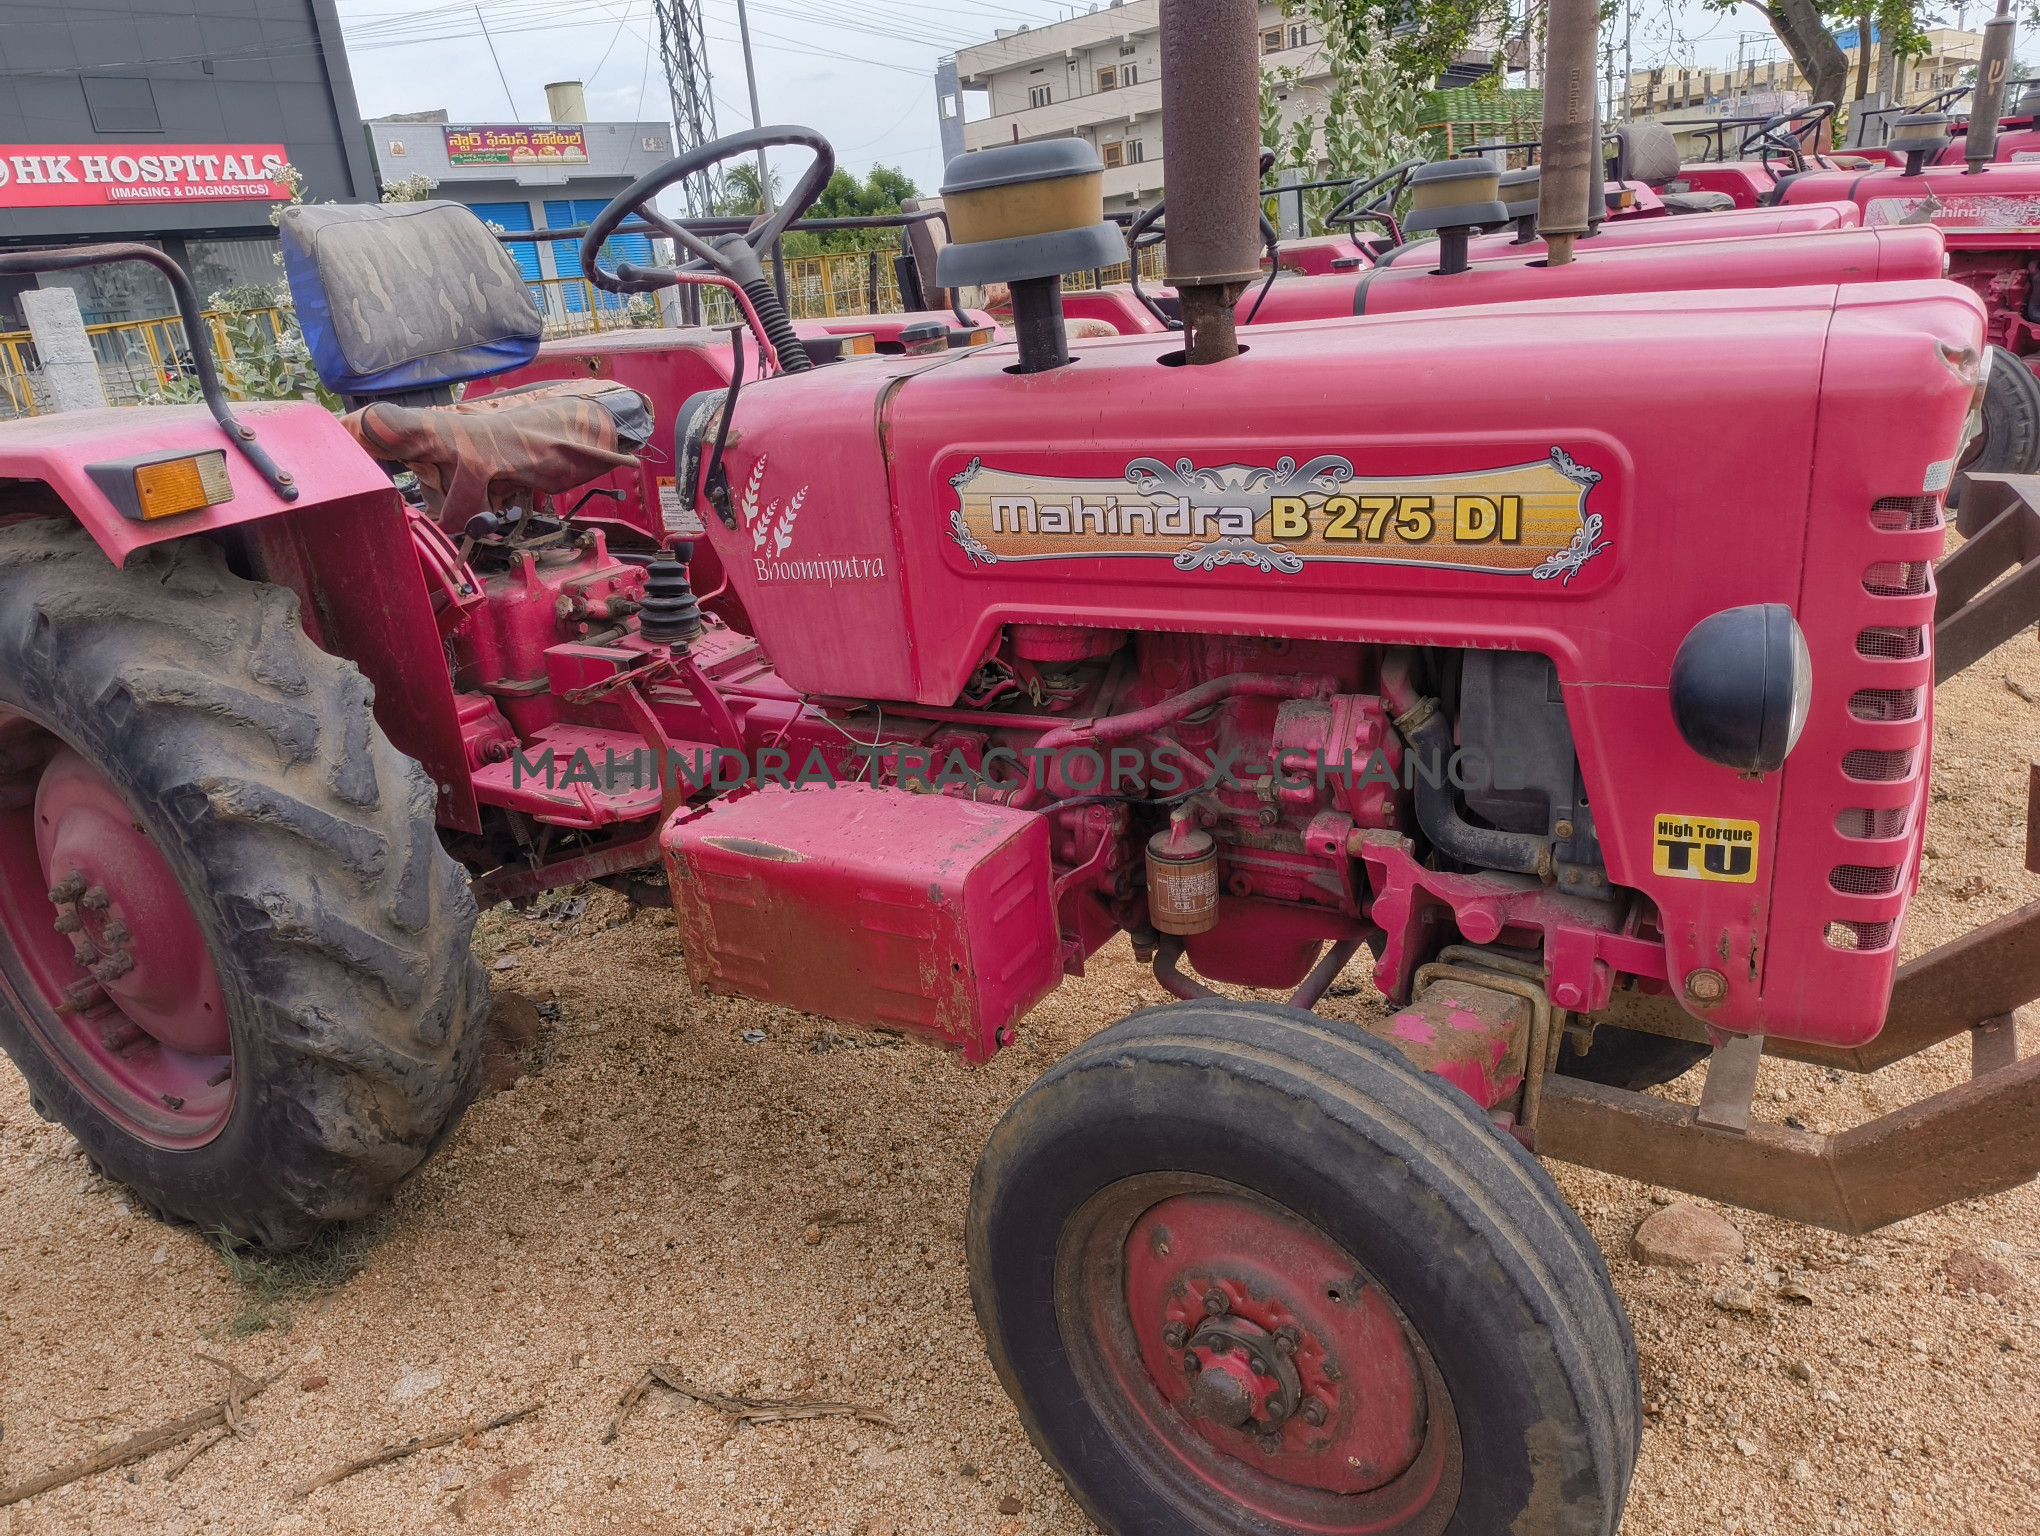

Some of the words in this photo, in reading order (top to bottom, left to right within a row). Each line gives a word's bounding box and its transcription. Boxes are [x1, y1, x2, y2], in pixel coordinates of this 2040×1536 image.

[10, 155, 78, 184] HK
[79, 154, 283, 184] HOSPITALS
[111, 186, 172, 199] (IMAGING
[174, 186, 183, 197] &
[184, 184, 269, 198] DIAGNOSTICS)
[1931, 206, 2001, 218] ahindra
[990, 496, 1254, 536] Mahindra
[1271, 496, 1310, 541] B
[1323, 495, 1434, 541] 275
[1453, 495, 1522, 542] DI
[753, 553, 886, 589] Bhoomiputra
[1658, 821, 1694, 838] High
[1697, 825, 1753, 842] Torque
[1657, 839, 1752, 875] TU
